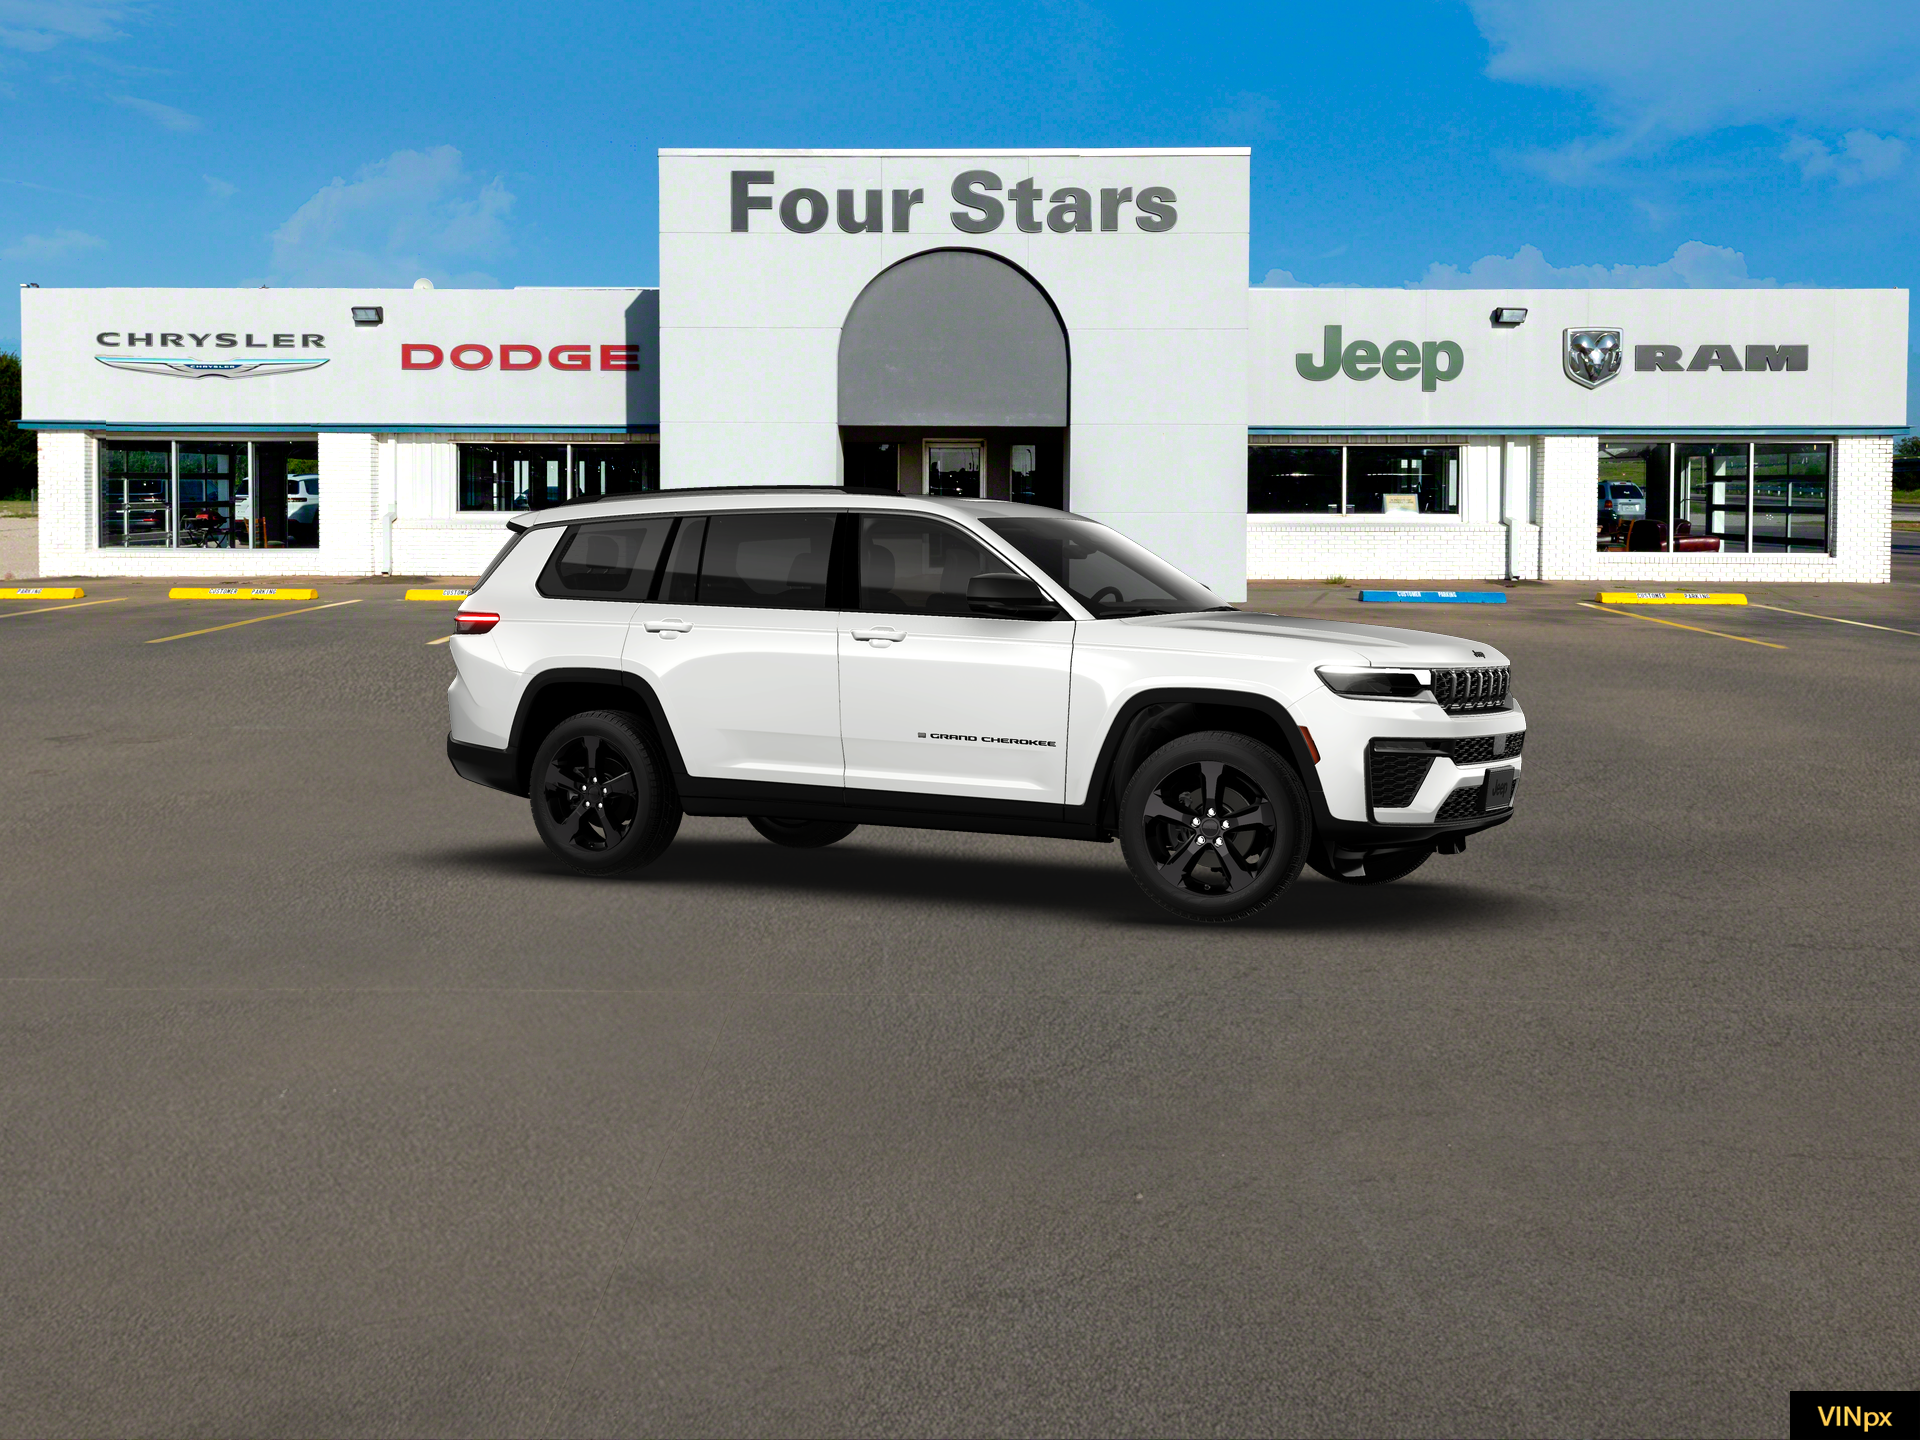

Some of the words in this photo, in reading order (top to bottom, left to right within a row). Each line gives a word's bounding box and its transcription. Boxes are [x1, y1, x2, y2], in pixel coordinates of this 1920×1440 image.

[730, 170, 924, 234] Four
[950, 169, 1178, 234] Stars
[96, 332, 327, 348] CHRYSLER
[401, 343, 640, 371] DODGE
[1295, 324, 1464, 392] Jeep
[1634, 344, 1809, 372] RAM
[929, 733, 978, 742] GRAND
[981, 736, 1056, 748] CHEROKEE
[1492, 779, 1508, 798] Jeep
